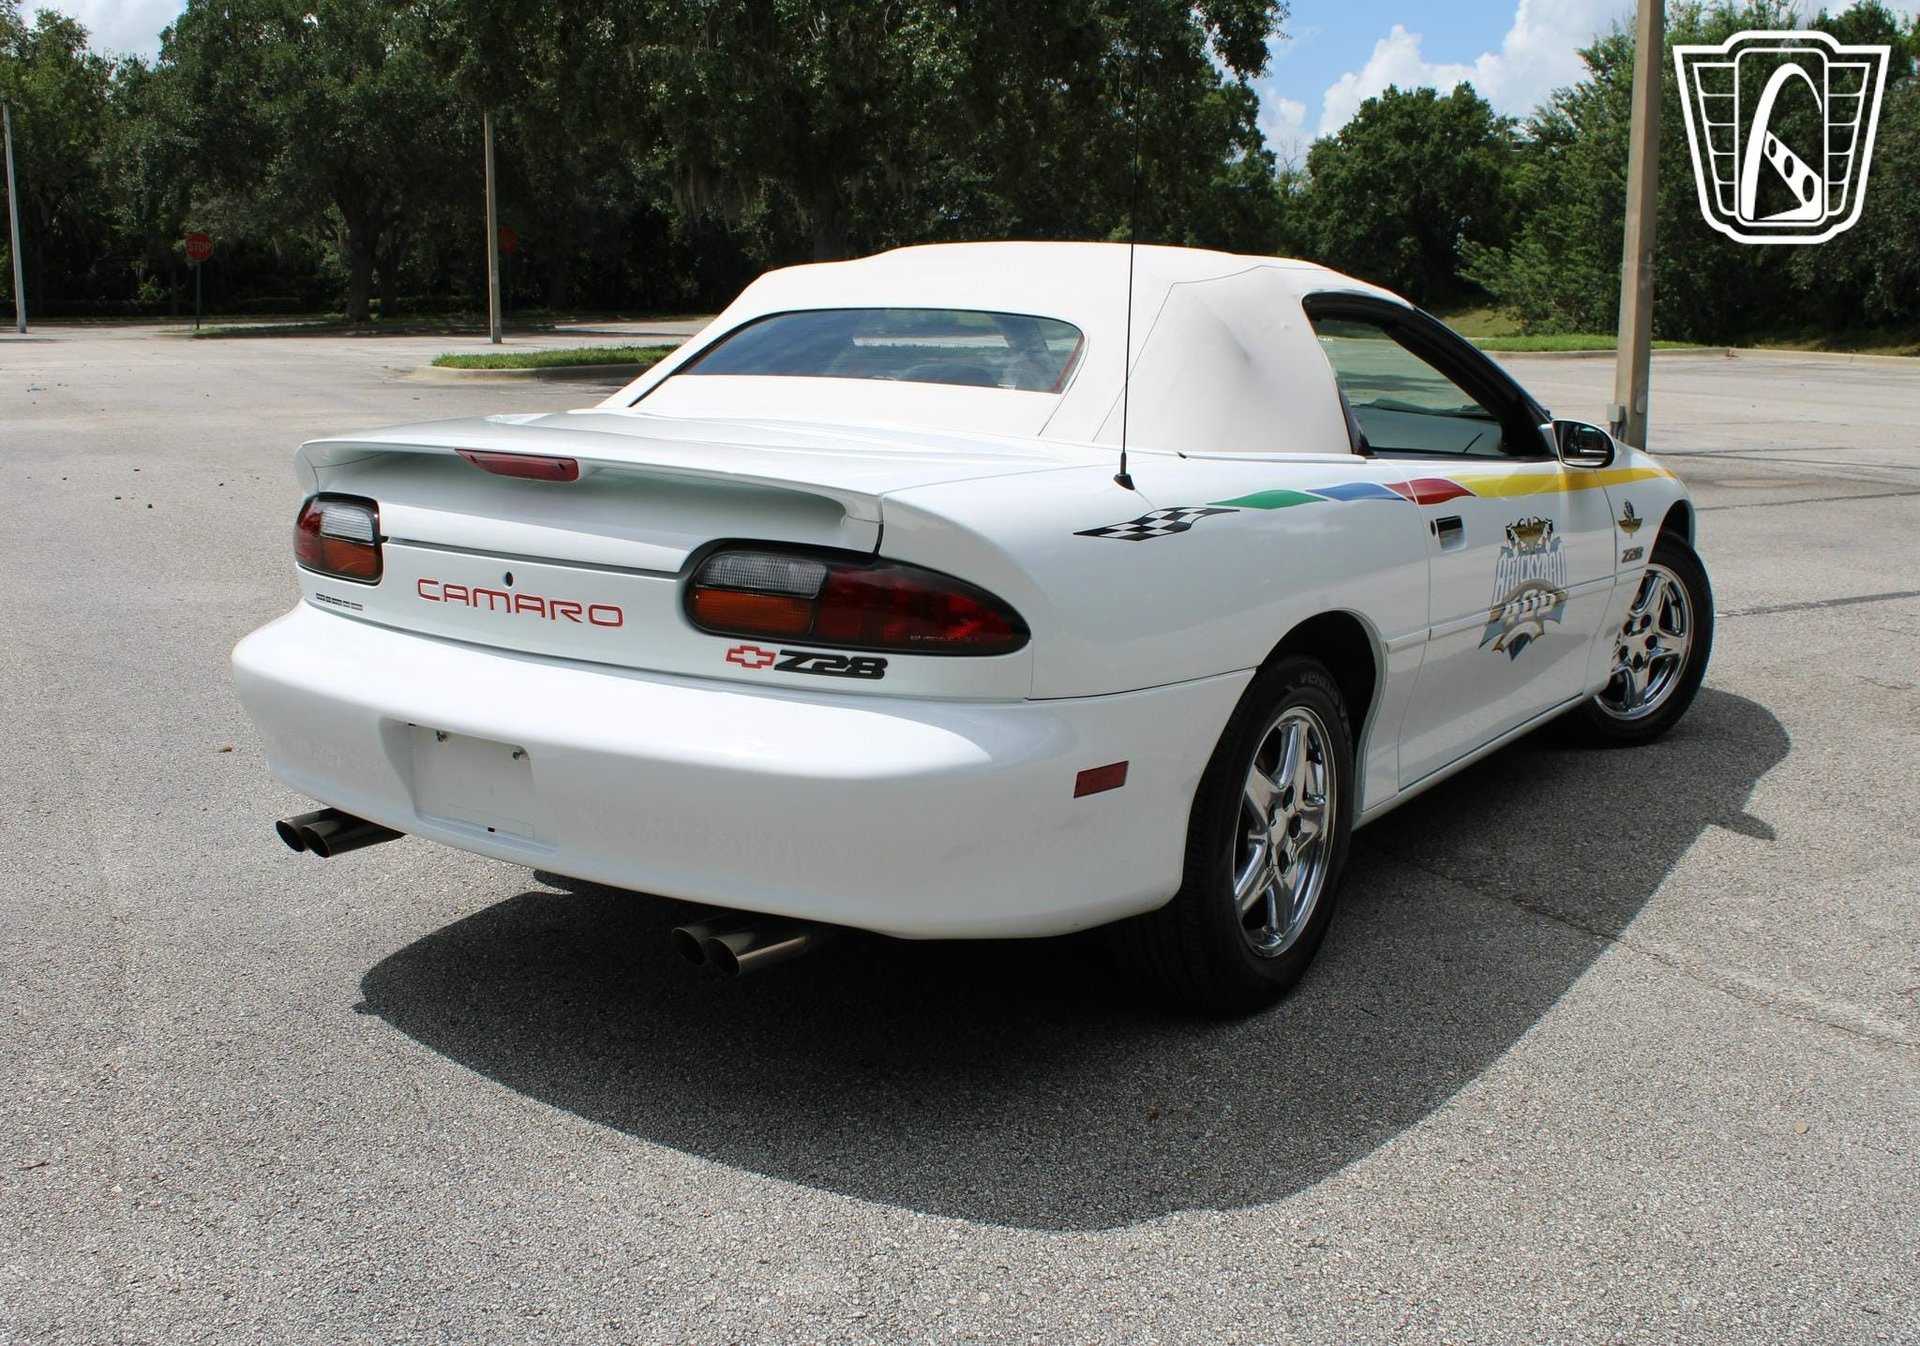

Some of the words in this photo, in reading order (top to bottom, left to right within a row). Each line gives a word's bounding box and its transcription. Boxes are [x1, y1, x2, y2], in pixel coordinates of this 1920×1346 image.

[187, 241, 212, 253] STOP
[417, 578, 624, 627] CAMARO
[1500, 589, 1557, 624] 400
[773, 649, 889, 680] Z28
